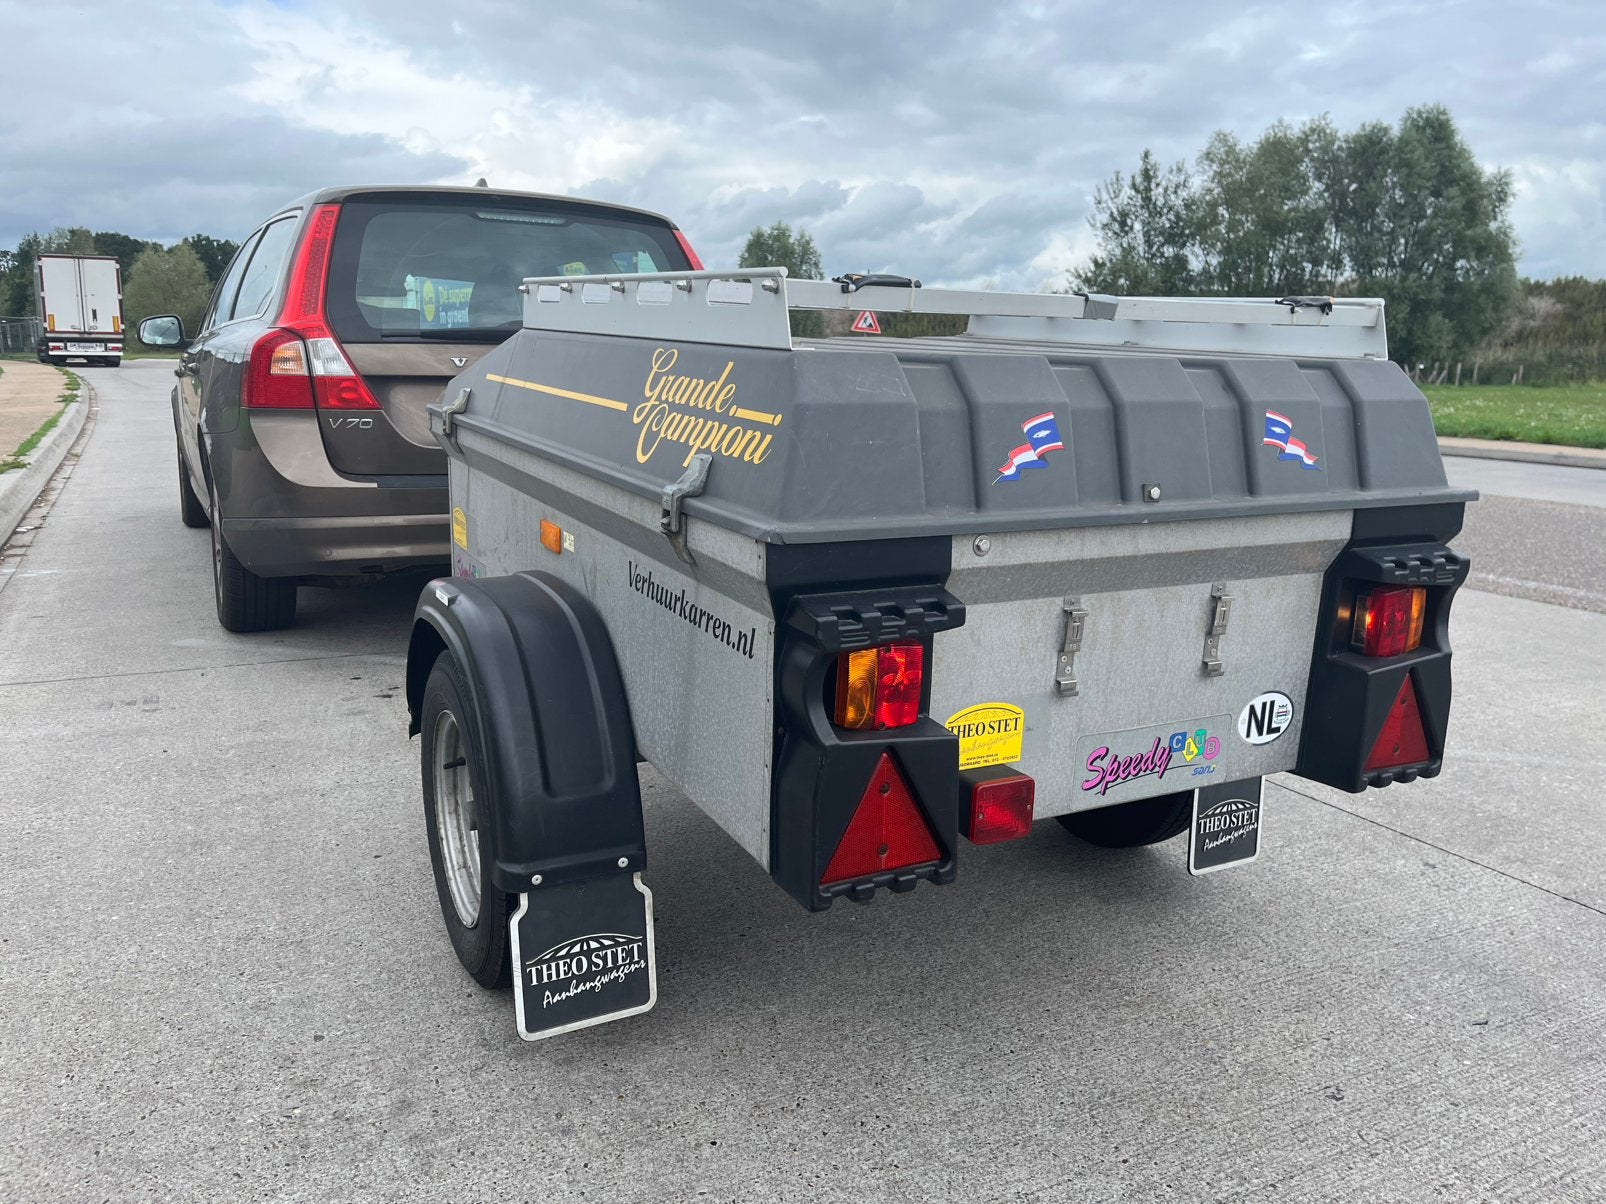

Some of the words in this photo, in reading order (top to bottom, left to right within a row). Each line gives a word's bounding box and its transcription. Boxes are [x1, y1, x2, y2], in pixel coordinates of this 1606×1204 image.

[632, 348, 737, 424] Grande
[635, 404, 782, 468] Campioni
[628, 560, 756, 659] Verhuurkarren.nl
[988, 717, 1021, 735] STET
[1246, 700, 1281, 738] NL
[1081, 736, 1173, 796] Speedy
[1170, 729, 1220, 760] CLUB
[1199, 814, 1230, 834] THEO
[1231, 808, 1258, 828] STET
[1203, 822, 1258, 852] Aanhangwagens
[527, 955, 588, 987] THEO
[591, 942, 643, 971] STET
[543, 960, 646, 1008] Aanhangwagens
